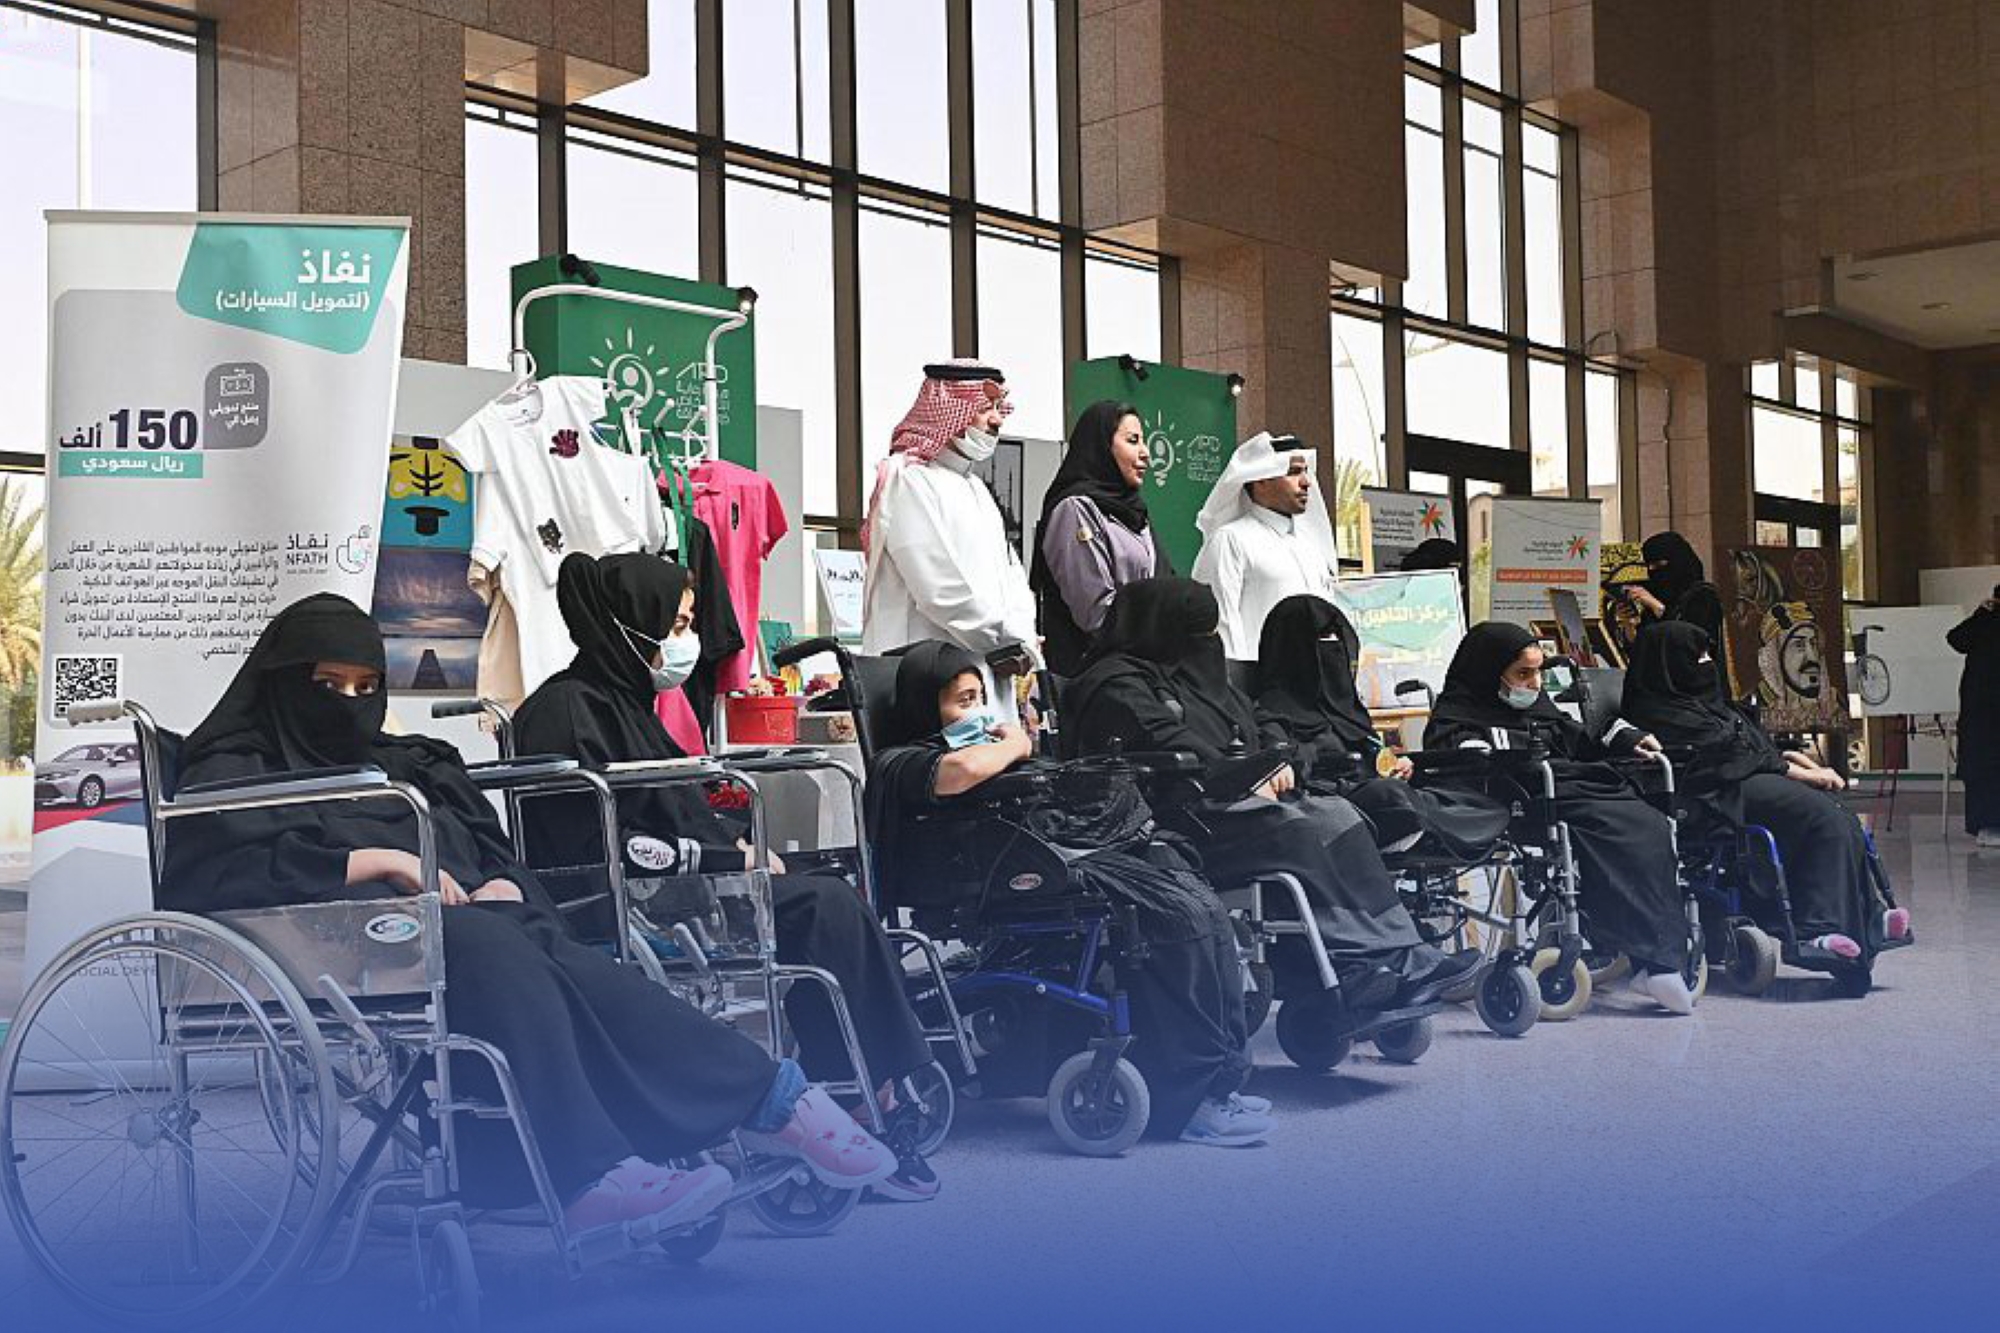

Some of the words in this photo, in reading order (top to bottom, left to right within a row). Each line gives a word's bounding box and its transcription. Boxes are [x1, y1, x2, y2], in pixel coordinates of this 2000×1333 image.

[297, 248, 372, 285] نفاذ
[216, 290, 297, 313] السيارات)
[302, 290, 370, 314] (لتمويل
[59, 421, 102, 450] ألف
[108, 408, 198, 451] 150
[82, 457, 147, 473] سعودي
[150, 456, 184, 473] ريال
[286, 552, 328, 566] NFATH
